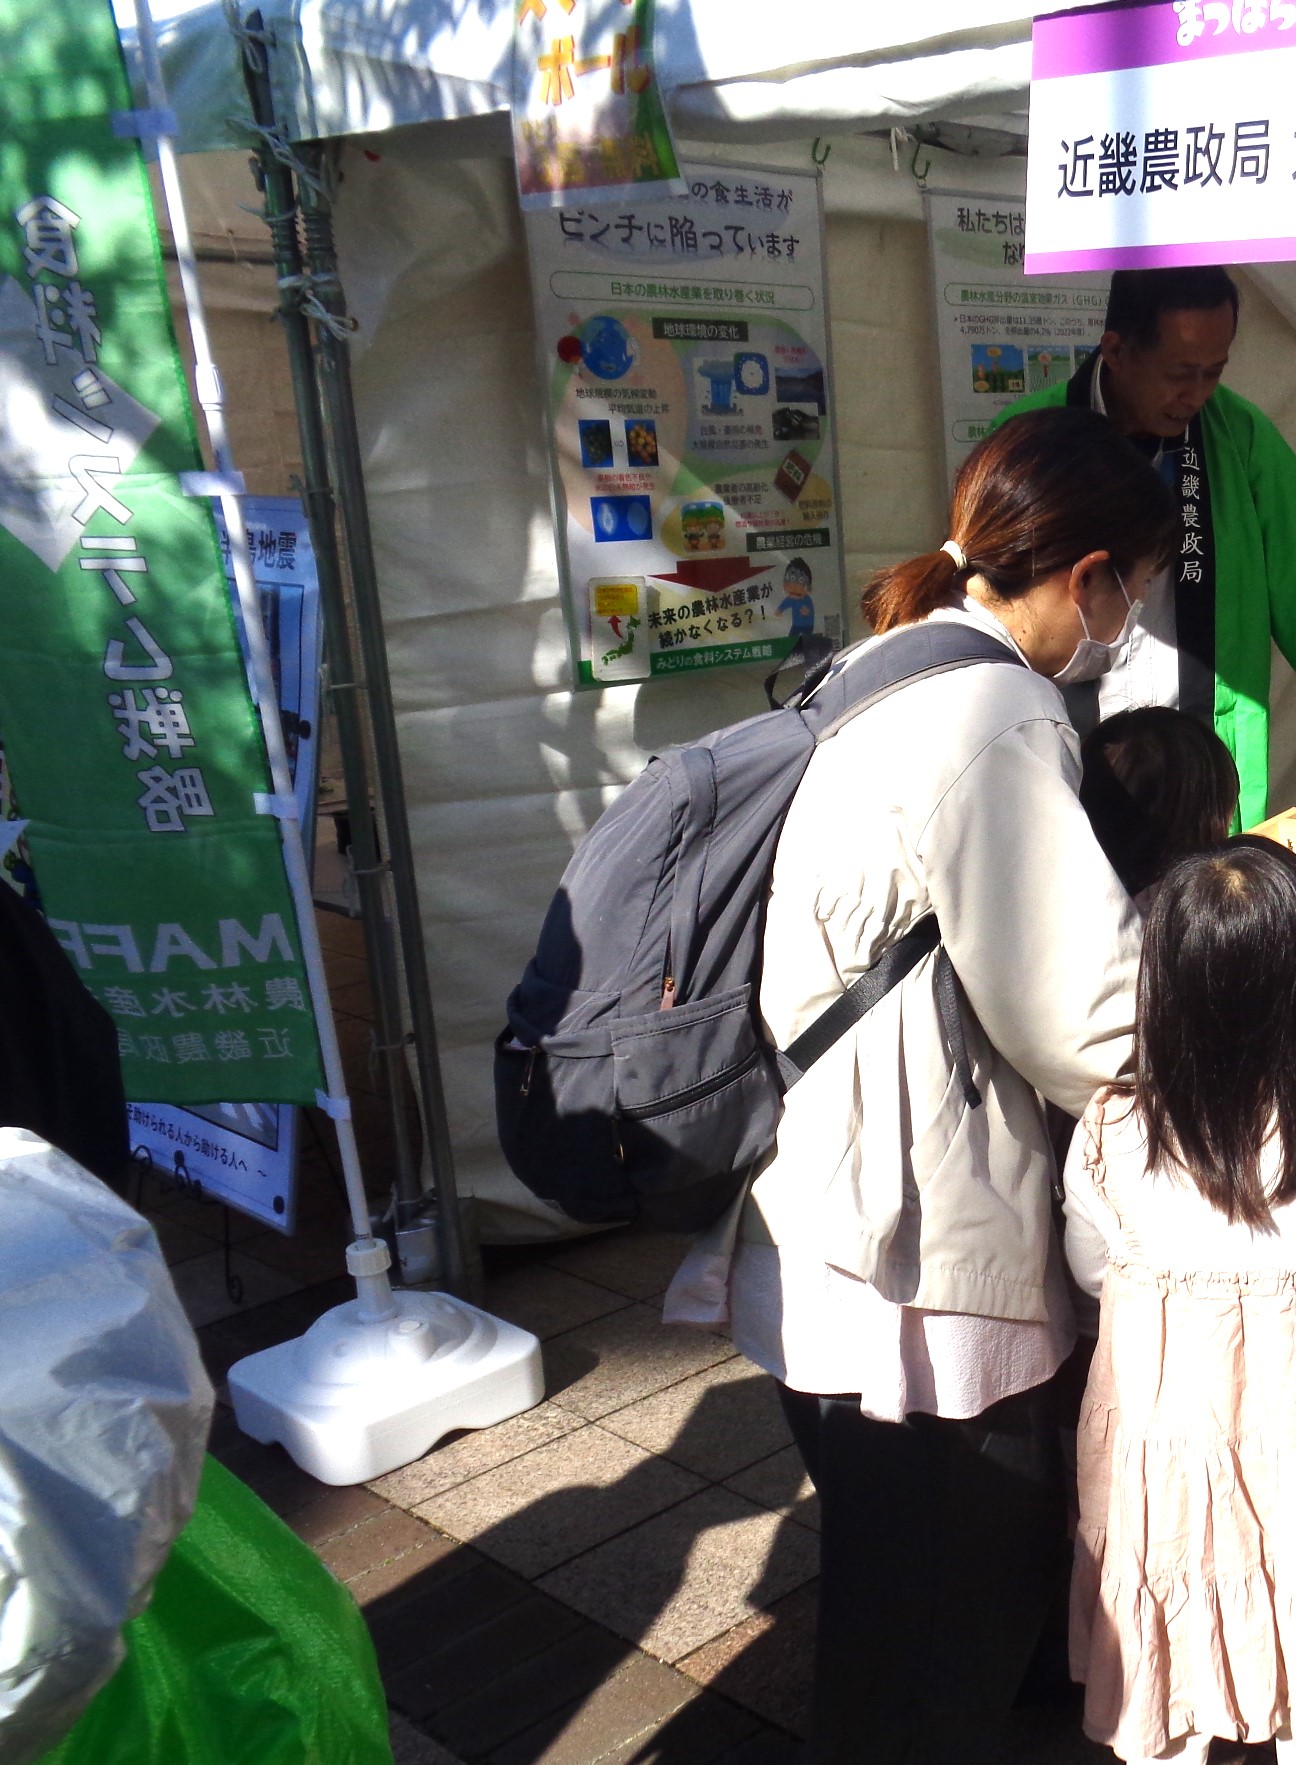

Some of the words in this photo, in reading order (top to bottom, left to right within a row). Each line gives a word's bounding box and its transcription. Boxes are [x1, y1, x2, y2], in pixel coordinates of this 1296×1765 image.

[1057, 119, 1271, 199] 近畿農政局
[691, 180, 794, 211] の食生活が
[663, 322, 740, 340] 地球環境の変化
[1179, 447, 1205, 584] 近畿農政局
[648, 582, 773, 629] 未来の農林水産業が
[656, 644, 773, 670] みどりの食料システム戦略
